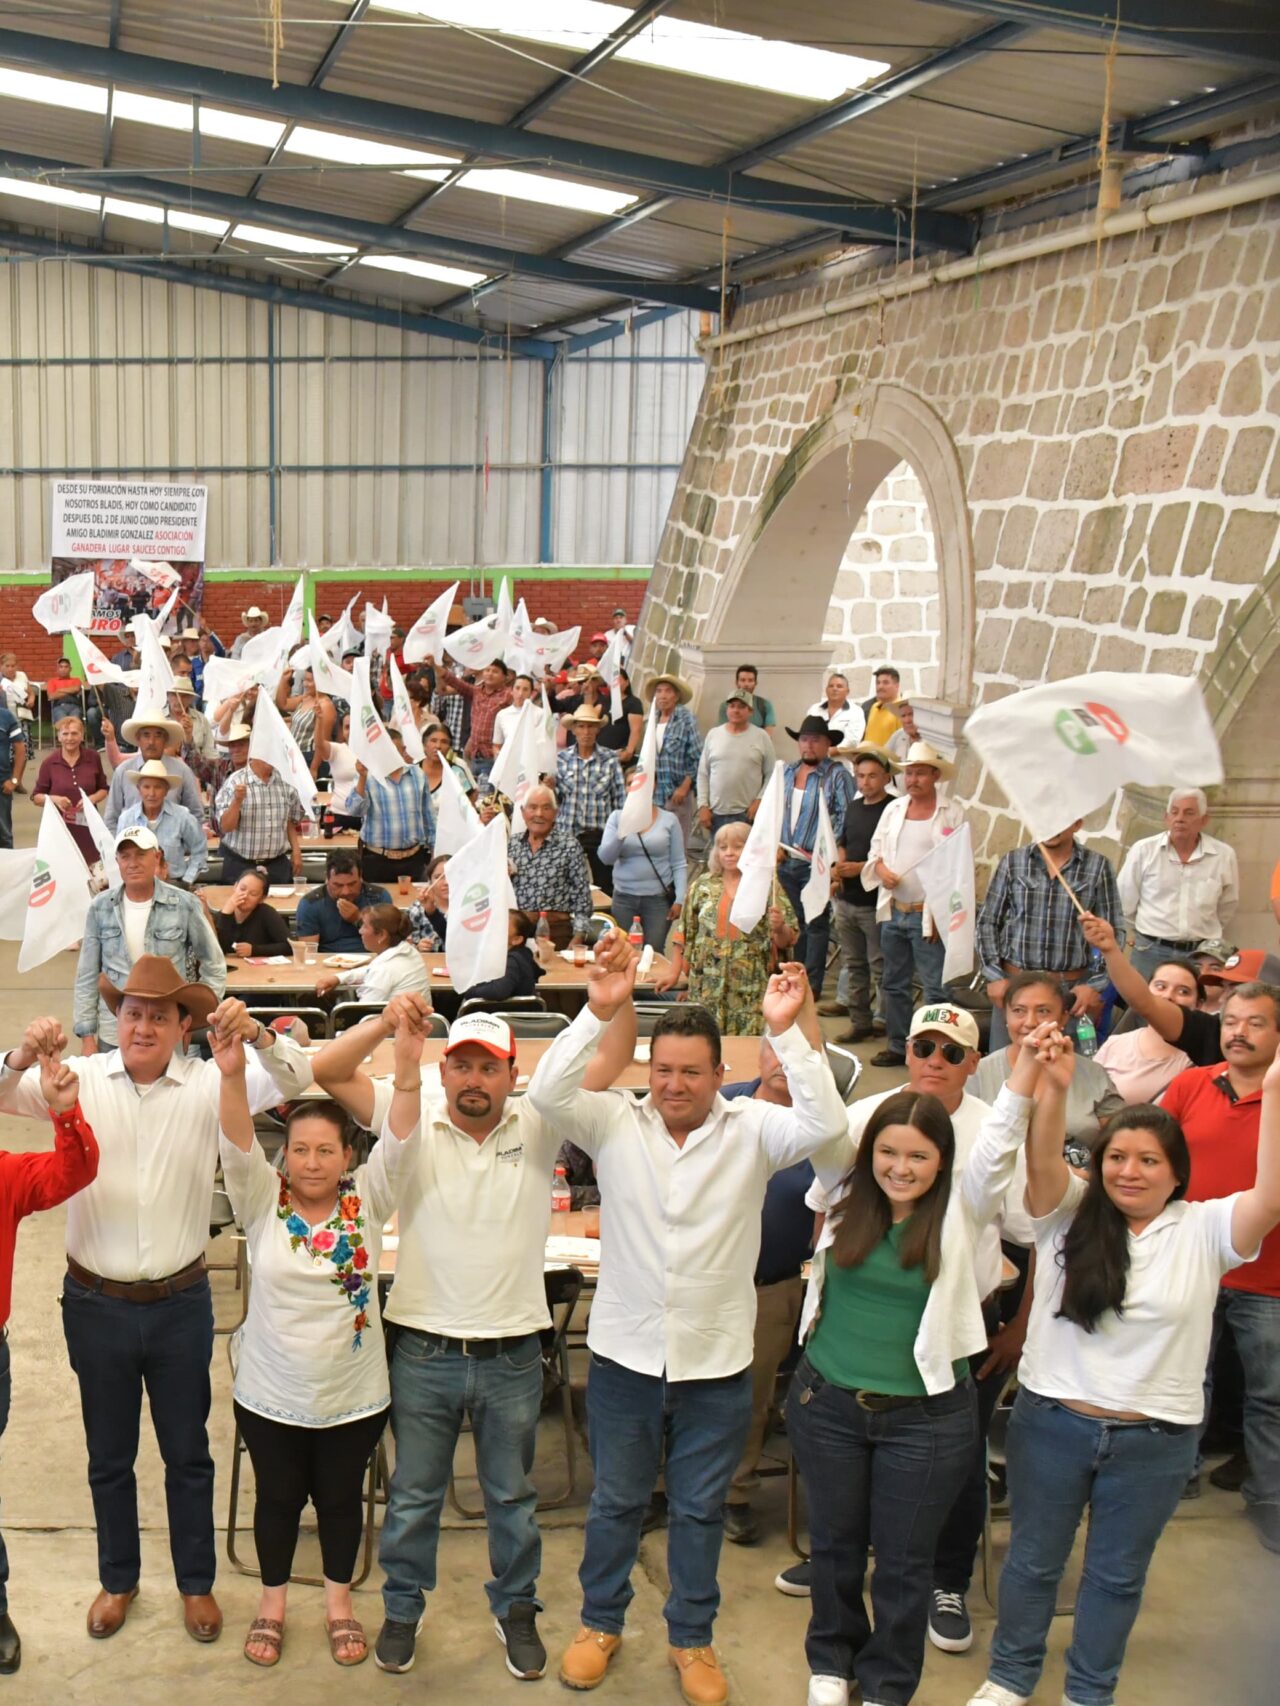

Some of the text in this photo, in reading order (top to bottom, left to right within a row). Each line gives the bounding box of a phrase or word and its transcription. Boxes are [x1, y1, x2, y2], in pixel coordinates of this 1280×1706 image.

[57, 484, 205, 498] DESDE SU FORMACIÓN HASTA HOY SIEMPRE CON
[65, 499, 197, 512] NOSOTROS BLADIS, HOY COMO CANDIDATO
[63, 513, 197, 527] DESPUES DEL 2 DE JUNIO COMO PRESIDENTE
[66, 528, 88, 538] AMIGO
[89, 528, 119, 539] BLADIMIR
[120, 529, 154, 541] GONZALEZ
[71, 542, 106, 553] GANADERA
[108, 543, 130, 553] LUGAR
[132, 544, 156, 555] SAUCES
[461, 883, 492, 932] PRI
[922, 1009, 959, 1027] MEX
